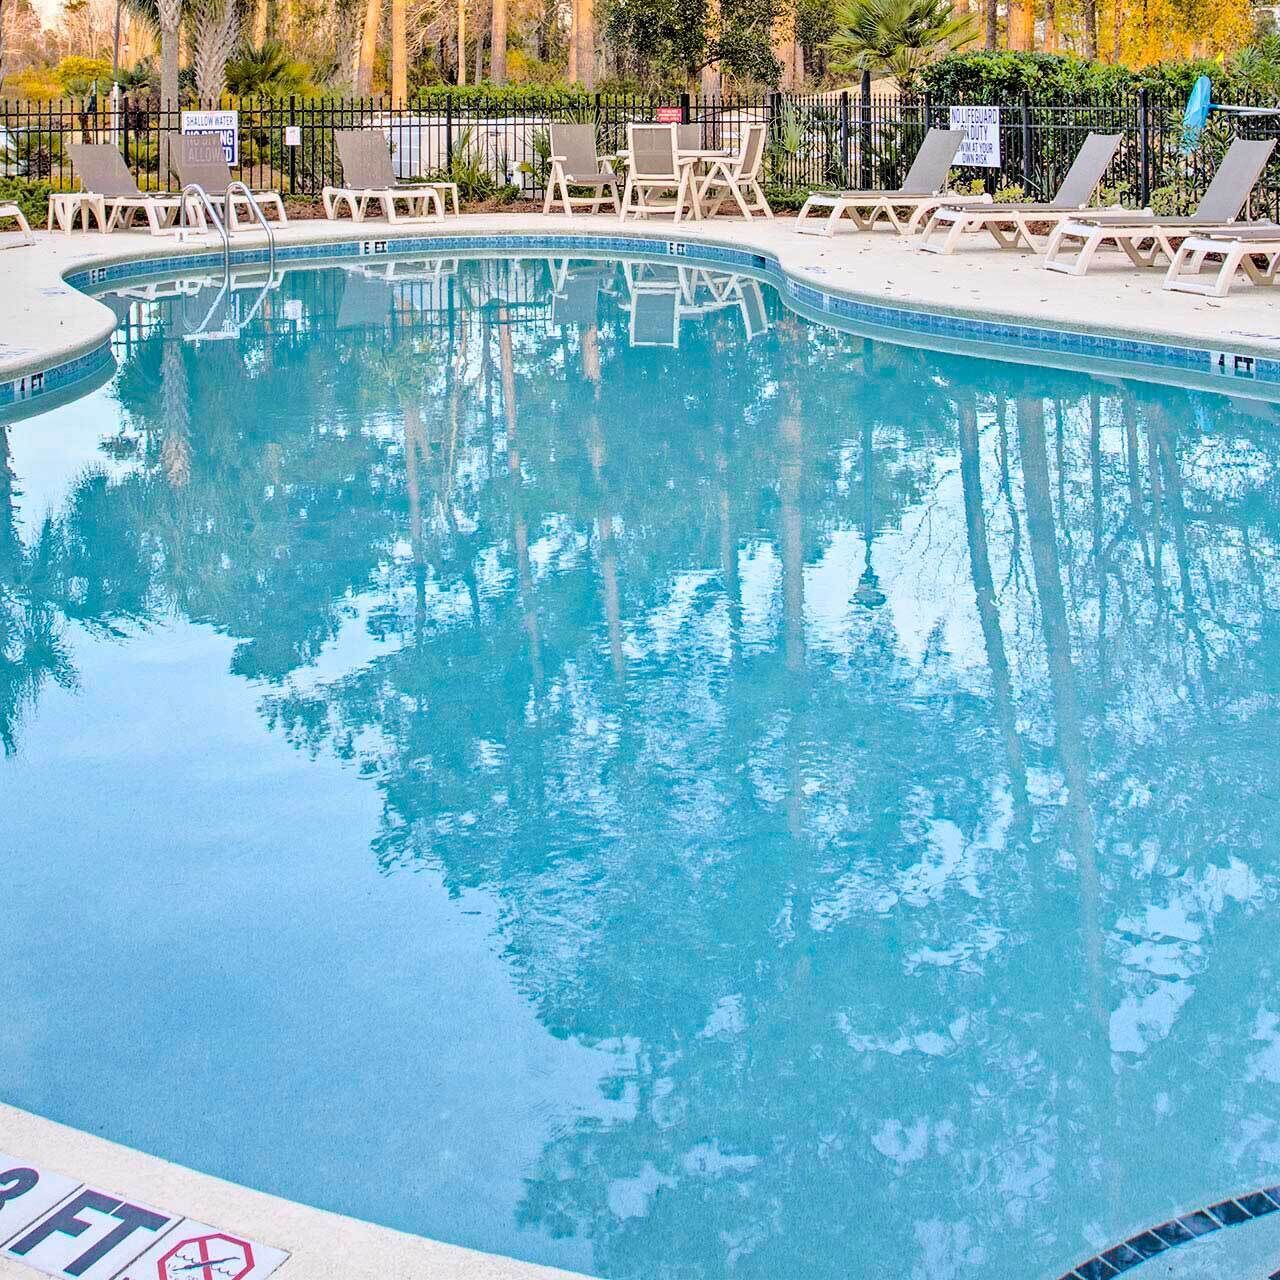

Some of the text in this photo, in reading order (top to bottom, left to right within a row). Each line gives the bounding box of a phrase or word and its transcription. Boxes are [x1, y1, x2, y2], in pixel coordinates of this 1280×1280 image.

[186, 115, 234, 127] SHALLOW WATER
[951, 108, 998, 124] NO LIFEGUARD
[971, 125, 989, 141] DUTY
[7, 1188, 172, 1277] FT
